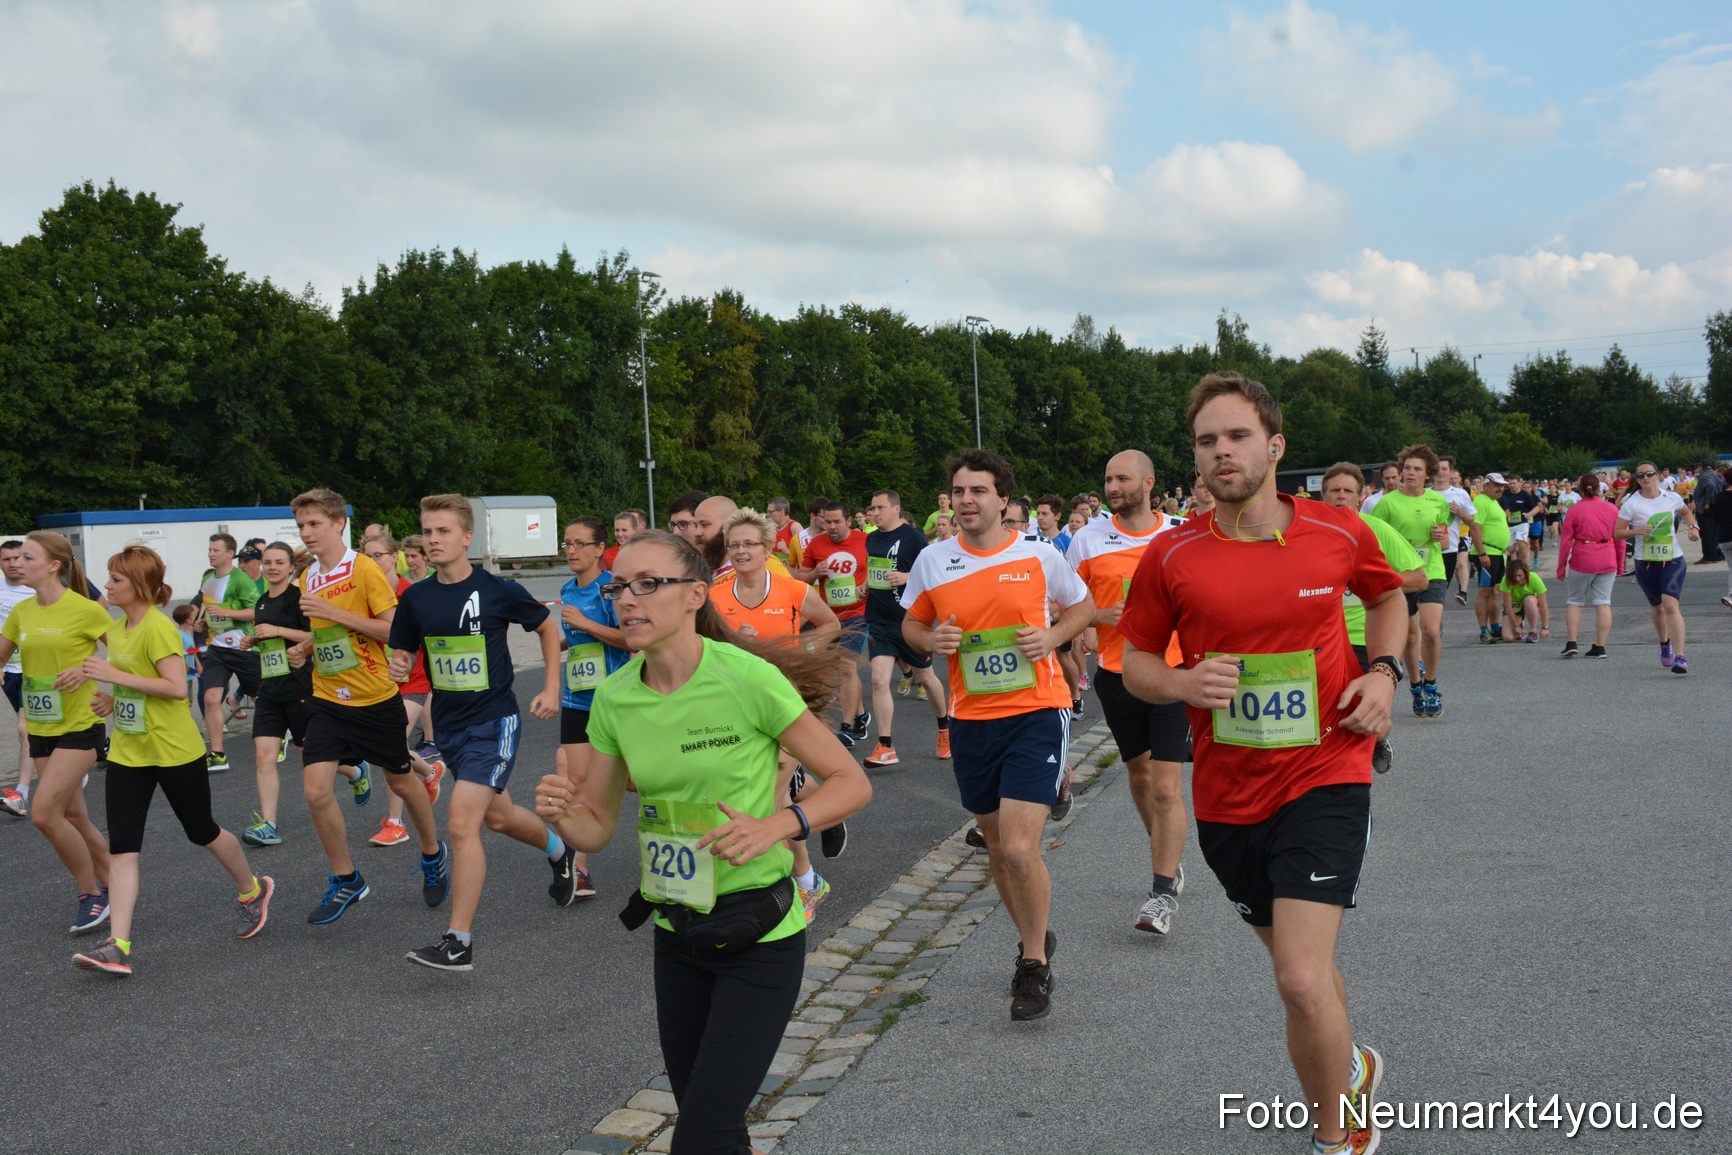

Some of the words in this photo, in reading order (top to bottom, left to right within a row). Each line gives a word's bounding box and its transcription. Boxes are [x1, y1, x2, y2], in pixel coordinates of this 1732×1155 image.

[1649, 545, 1668, 554] 116
[828, 559, 853, 574] 48
[327, 581, 357, 599] BÖGL
[831, 588, 850, 599] 502
[1298, 586, 1334, 598] Alexander
[262, 652, 284, 667] 1251
[316, 644, 345, 662] 865
[435, 657, 481, 675] 1146
[571, 661, 596, 678] 449
[974, 652, 1018, 676] 489
[27, 695, 52, 710] 626
[115, 700, 136, 719] 629
[1229, 690, 1307, 721] 1048
[686, 728, 704, 736] Team
[1235, 726, 1265, 735] Alexander
[1267, 727, 1294, 735] Schmidt
[680, 742, 707, 753] SMART
[709, 735, 742, 749] POWER
[647, 841, 696, 880] 220
